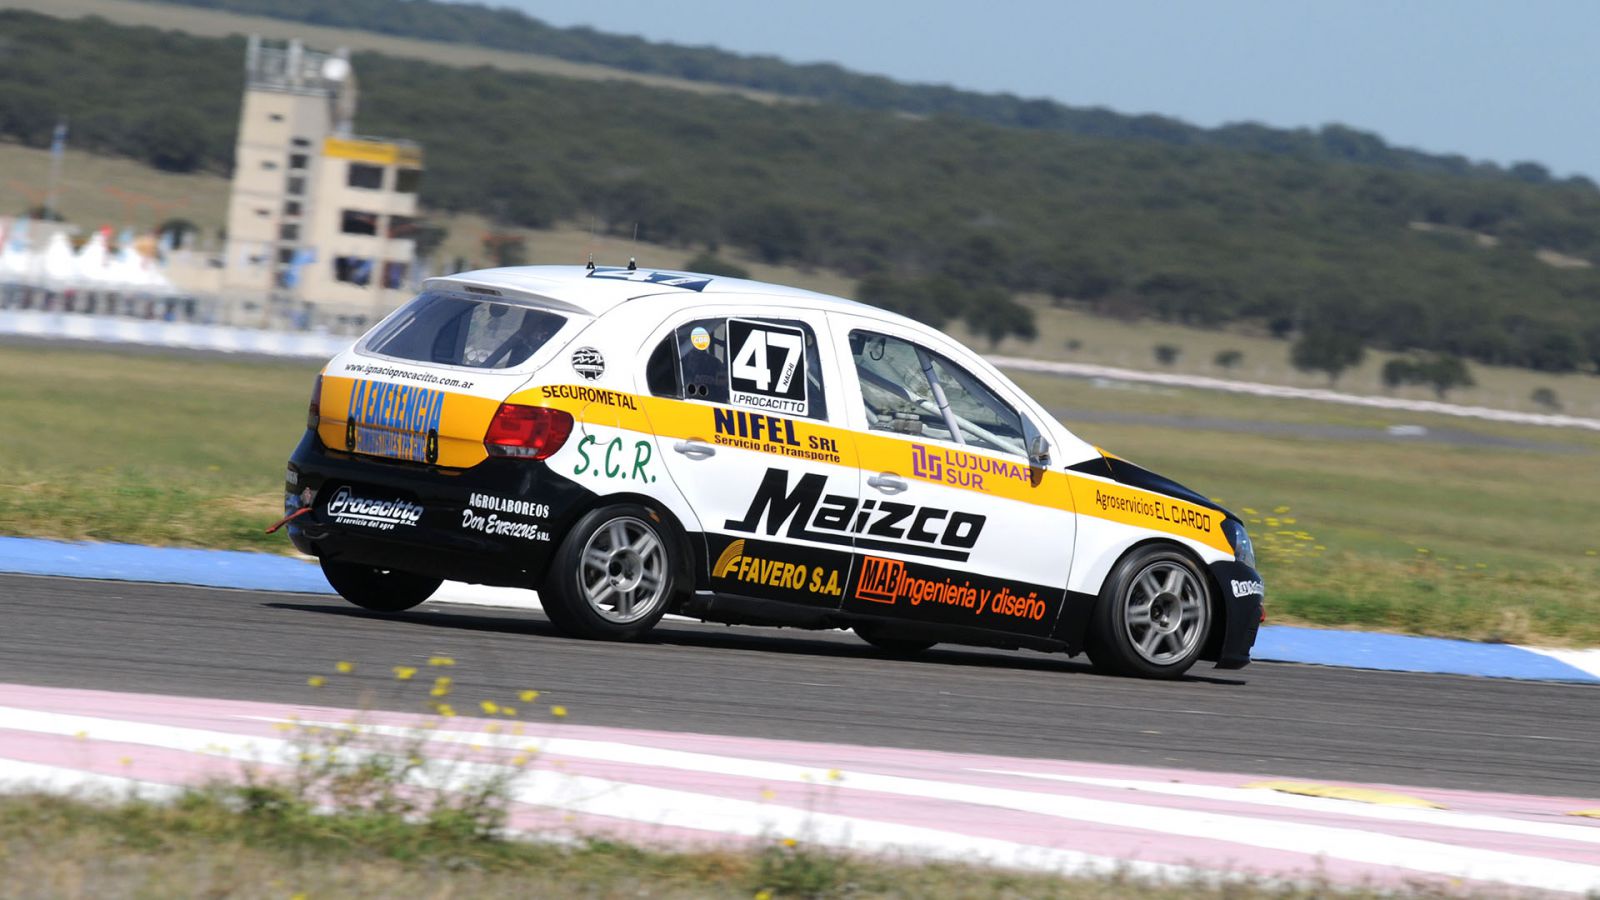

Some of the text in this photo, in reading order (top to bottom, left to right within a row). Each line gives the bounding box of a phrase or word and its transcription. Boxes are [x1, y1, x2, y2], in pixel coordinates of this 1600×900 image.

[345, 363, 474, 389] www.ignacioprocacitto.com.ar
[732, 329, 802, 393] 47
[783, 363, 794, 387] NACHI
[347, 379, 445, 433] LA EXELENCIA
[541, 385, 638, 411] SEGUROMETAL
[713, 407, 839, 453] NIFEL SRL
[573, 434, 656, 484] S.C.R.
[714, 434, 840, 463] Servicio de Transporte
[946, 468, 984, 490] SUR
[330, 490, 424, 521] Procacitto
[469, 492, 550, 519] AGROLABOREOS
[724, 467, 987, 553] Maizco
[1095, 489, 1210, 532] Agroservicios EL CARDO
[343, 518, 367, 526] servicio
[379, 522, 395, 530] agro
[808, 566, 842, 596] S.A.
[860, 556, 1046, 621] MAB Ingenieria y diseño
